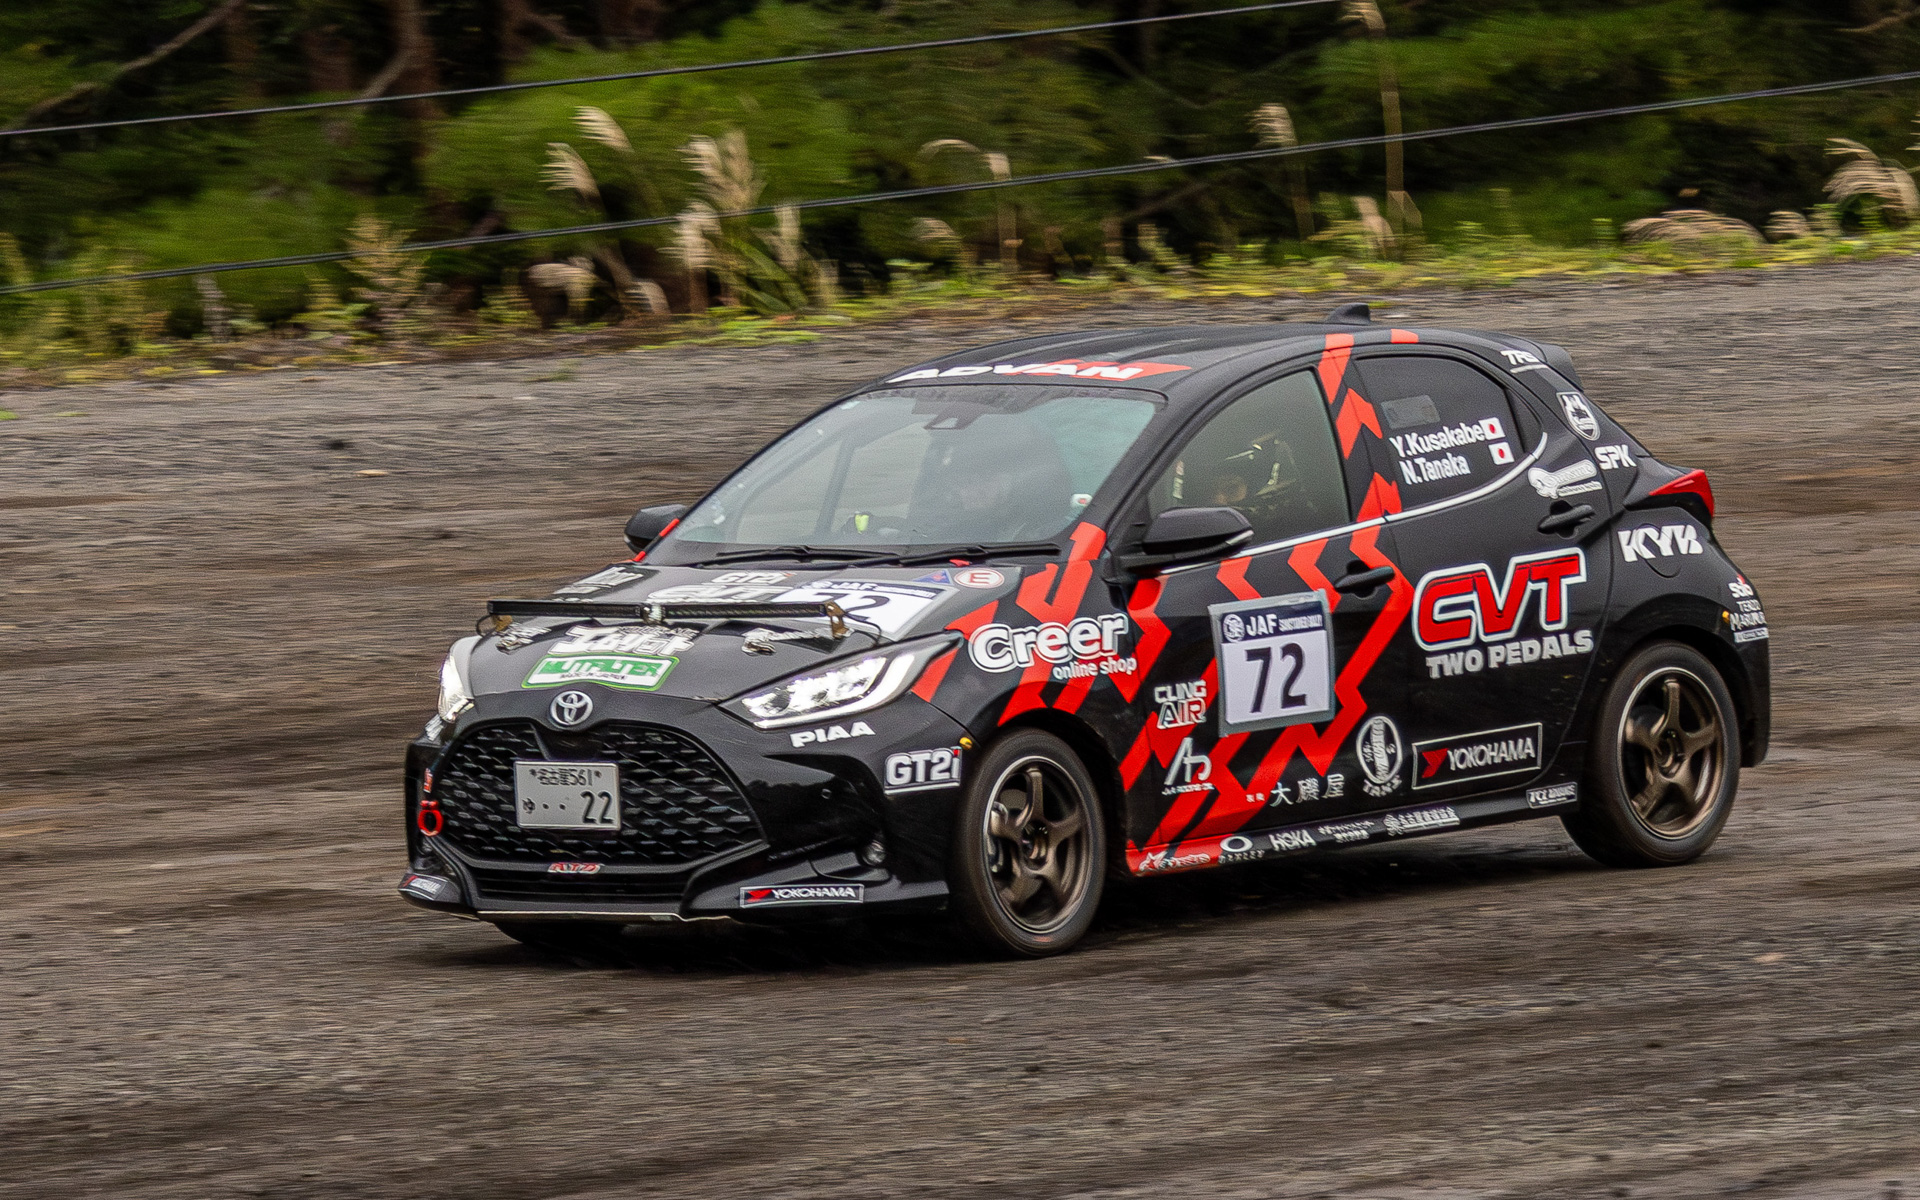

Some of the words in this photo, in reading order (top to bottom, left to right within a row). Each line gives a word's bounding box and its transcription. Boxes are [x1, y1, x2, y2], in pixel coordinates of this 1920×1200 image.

[885, 363, 1143, 384] ADVAN
[1389, 422, 1486, 457] Y.Kusakabe
[1399, 452, 1471, 485] N.Tanaka
[1595, 444, 1637, 470] SPK
[1617, 524, 1703, 563] KYB
[1412, 547, 1587, 651] CVT
[1246, 613, 1277, 636] JAF
[968, 613, 1128, 673] Creer
[1426, 649, 1484, 679] TWO
[1487, 630, 1594, 668] PEDALS
[1053, 660, 1099, 680] online
[1100, 656, 1137, 675] shop
[1244, 642, 1307, 714] 72
[1154, 680, 1207, 703] CLING
[1157, 697, 1207, 730] AIR
[789, 721, 876, 748] PIAA
[885, 747, 962, 786] GT2i
[1447, 737, 1536, 771] YOKOHAMA
[1268, 829, 1317, 851] HOKA
[772, 886, 856, 899] YOKOHAMA
